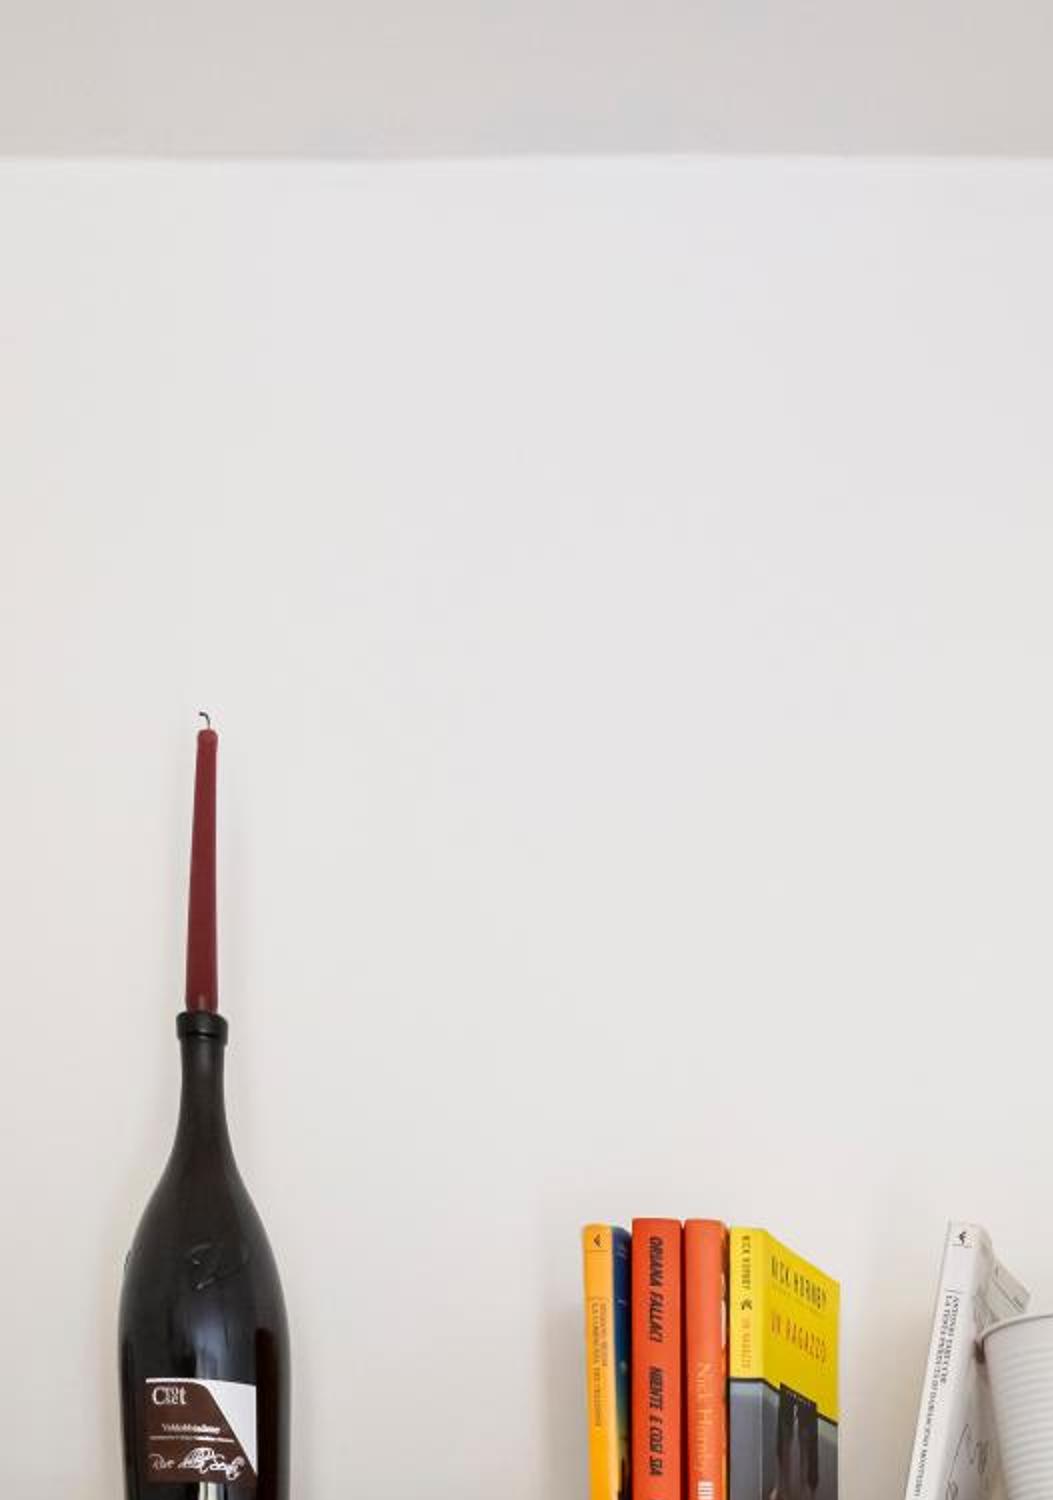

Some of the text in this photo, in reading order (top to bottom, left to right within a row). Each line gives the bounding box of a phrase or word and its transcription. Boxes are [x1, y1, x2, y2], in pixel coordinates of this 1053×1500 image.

[649, 1236, 664, 1343] ORIANA FALLACI
[649, 1365, 663, 1411] NIENTE
[697, 1362, 714, 1400] Nick
[649, 1415, 663, 1424] E
[694, 1407, 714, 1473] Hornby
[649, 1455, 663, 1477] SIA
